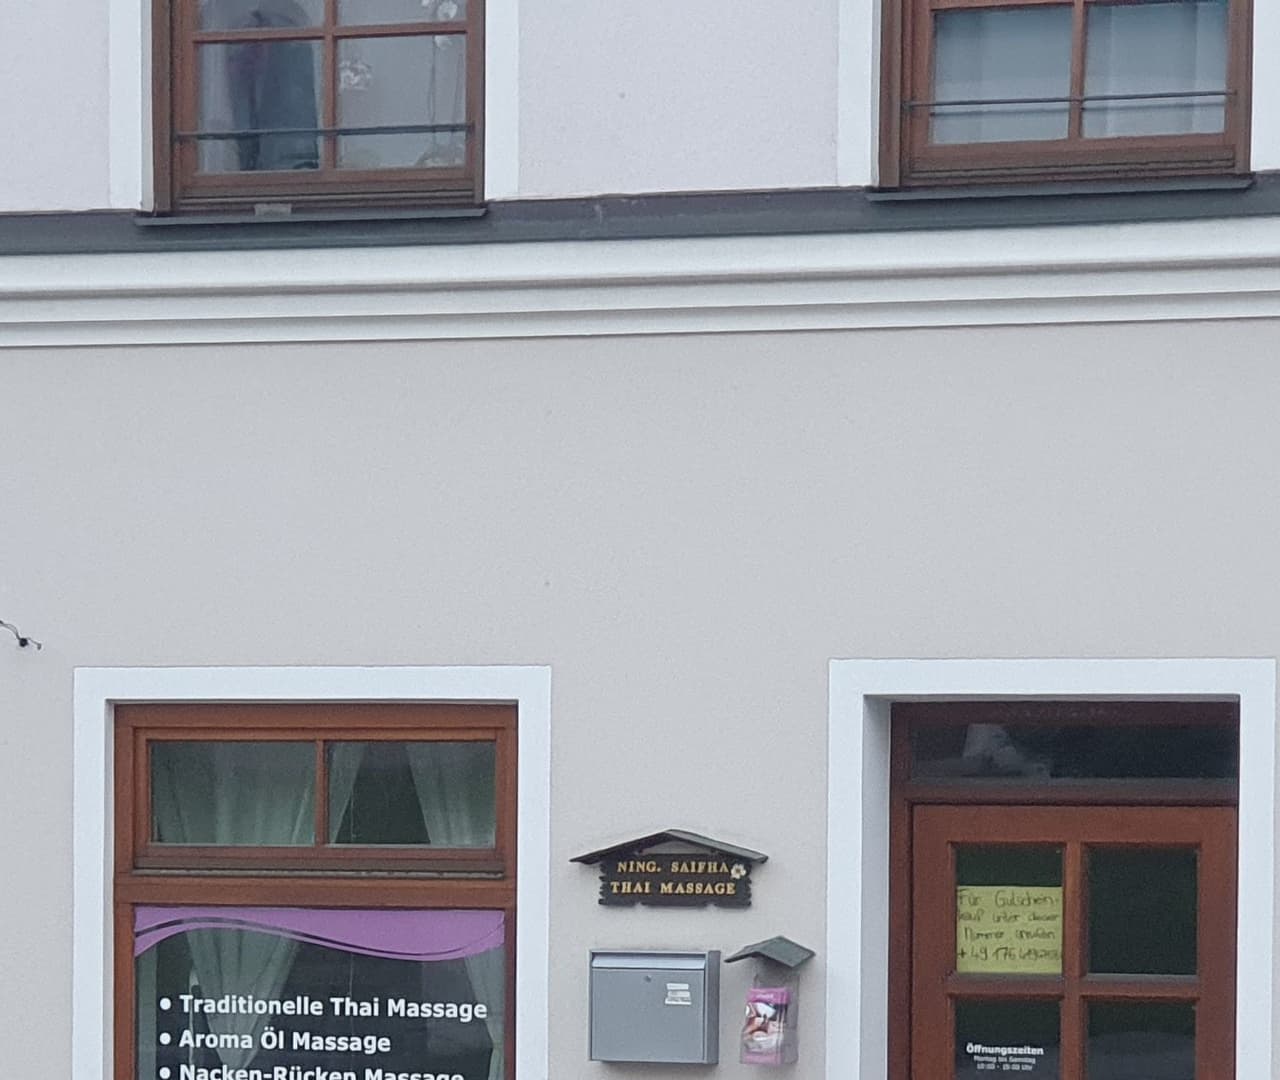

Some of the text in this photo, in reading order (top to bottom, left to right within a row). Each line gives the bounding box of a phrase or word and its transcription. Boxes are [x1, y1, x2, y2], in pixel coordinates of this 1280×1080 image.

[617, 860, 662, 873] NING.
[609, 881, 737, 895] THAI MASSAGE
[179, 995, 487, 1022] Traditionelle Thai Massage
[179, 1026, 391, 1055] Aroma Öl Massage
[966, 1042, 1045, 1056] Öffnungszeiten
